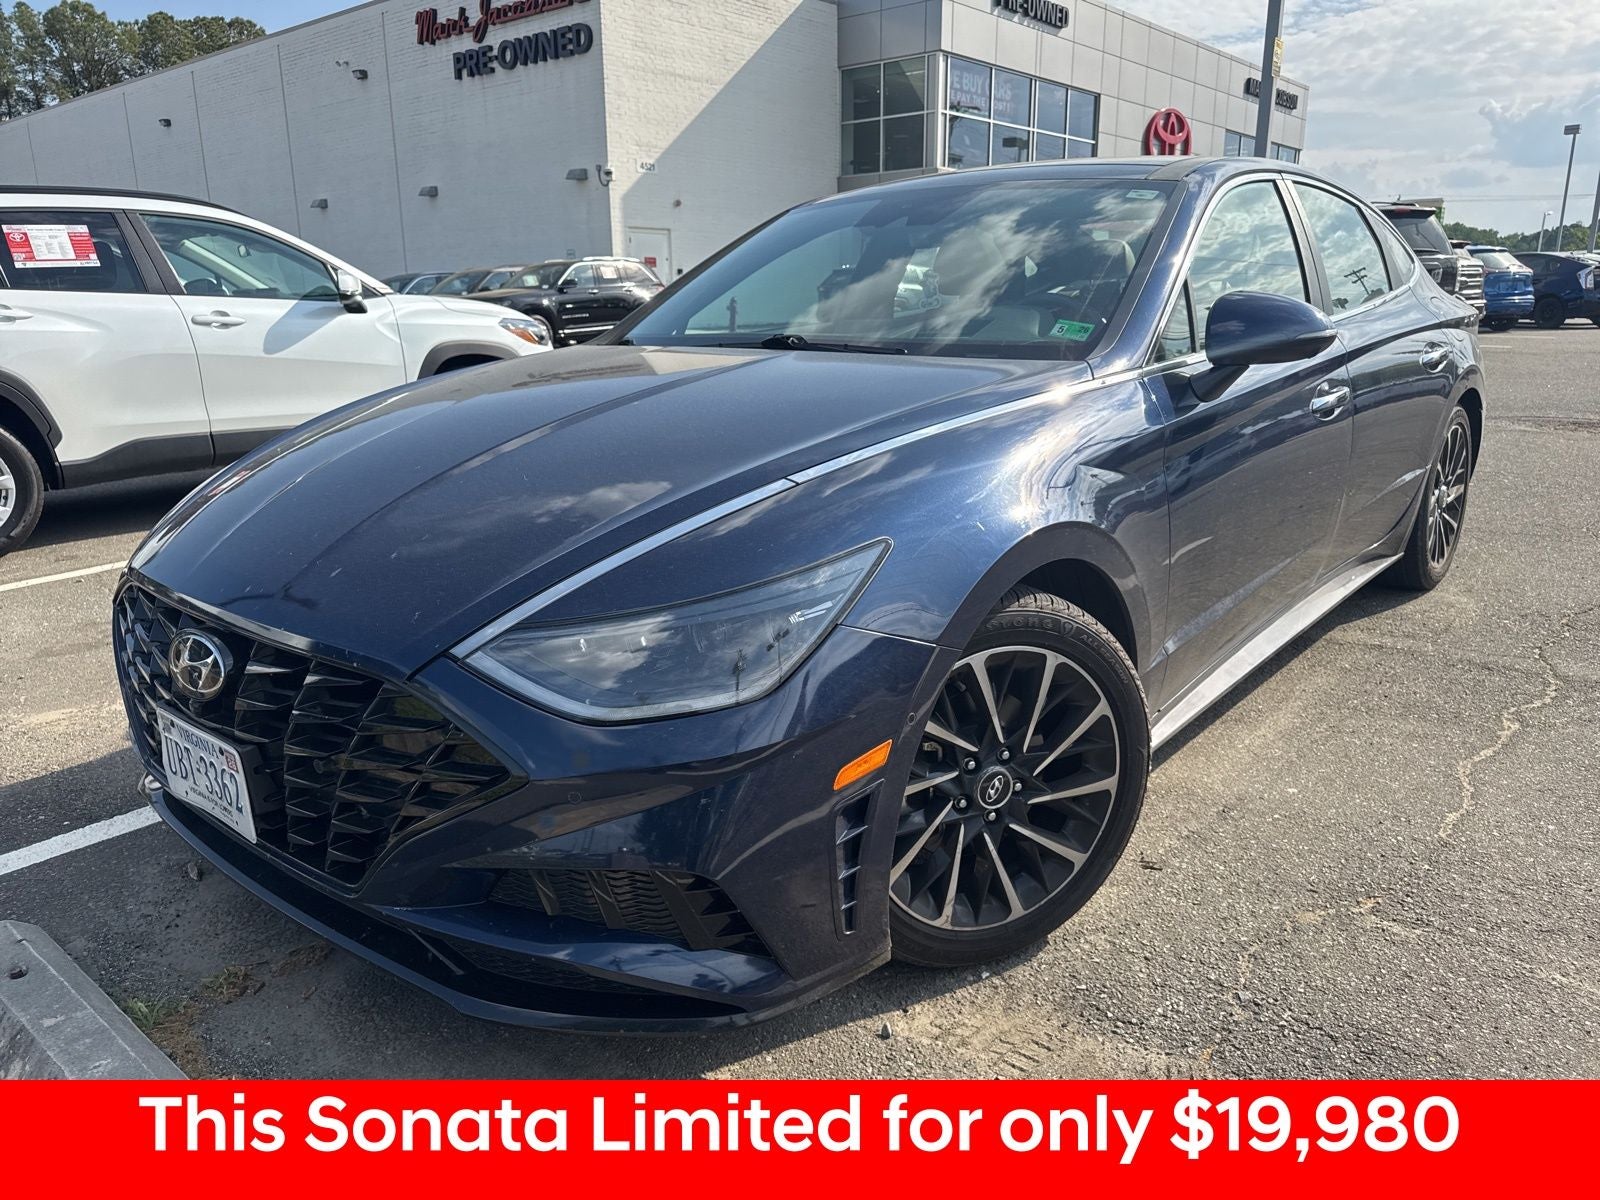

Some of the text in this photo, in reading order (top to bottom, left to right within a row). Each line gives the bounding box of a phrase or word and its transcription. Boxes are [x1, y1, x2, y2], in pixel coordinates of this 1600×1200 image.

[415, 6, 473, 46] Mark
[453, 23, 594, 80] PRE-OWNED
[962, 72, 984, 94] BUY
[1057, 325, 1066, 334] 5
[177, 723, 220, 760] VIRGINIA
